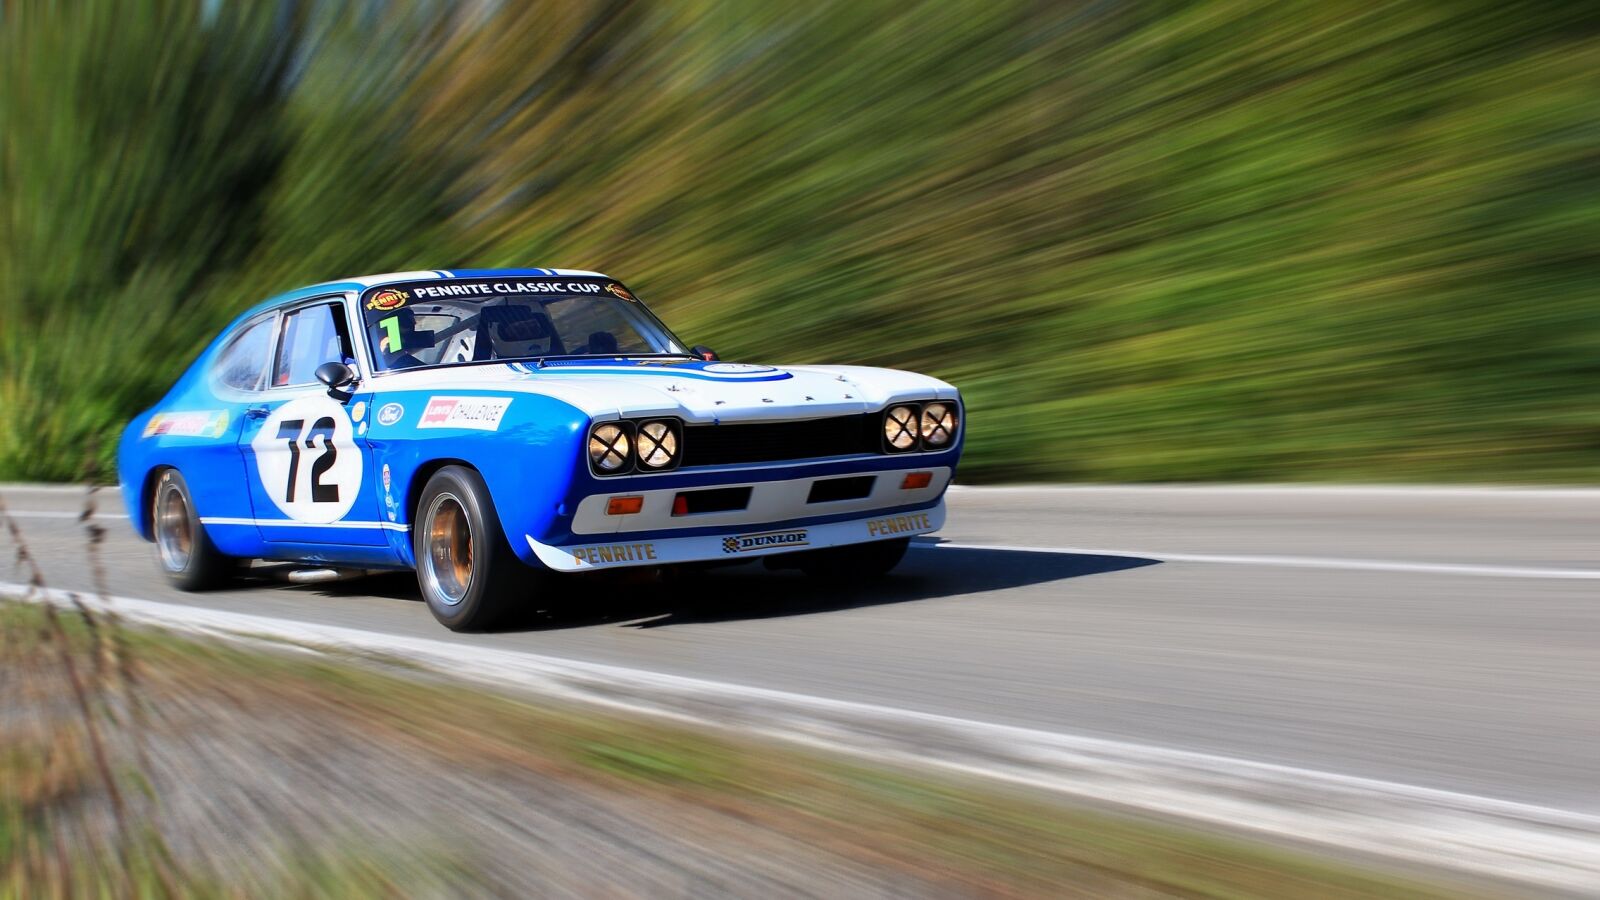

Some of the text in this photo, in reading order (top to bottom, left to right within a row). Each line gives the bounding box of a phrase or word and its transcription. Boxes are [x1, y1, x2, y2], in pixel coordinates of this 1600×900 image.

[366, 290, 410, 310] PENRITE
[413, 283, 493, 298] PENRITE
[493, 282, 567, 293] CLASSIC
[567, 283, 601, 293] CUP
[379, 315, 402, 354] 1
[452, 404, 503, 421] CHALLENGE
[275, 416, 340, 503] 72
[868, 513, 931, 536] PENRITE
[741, 532, 807, 548] DUNLOP
[572, 543, 657, 566] PENRITE
